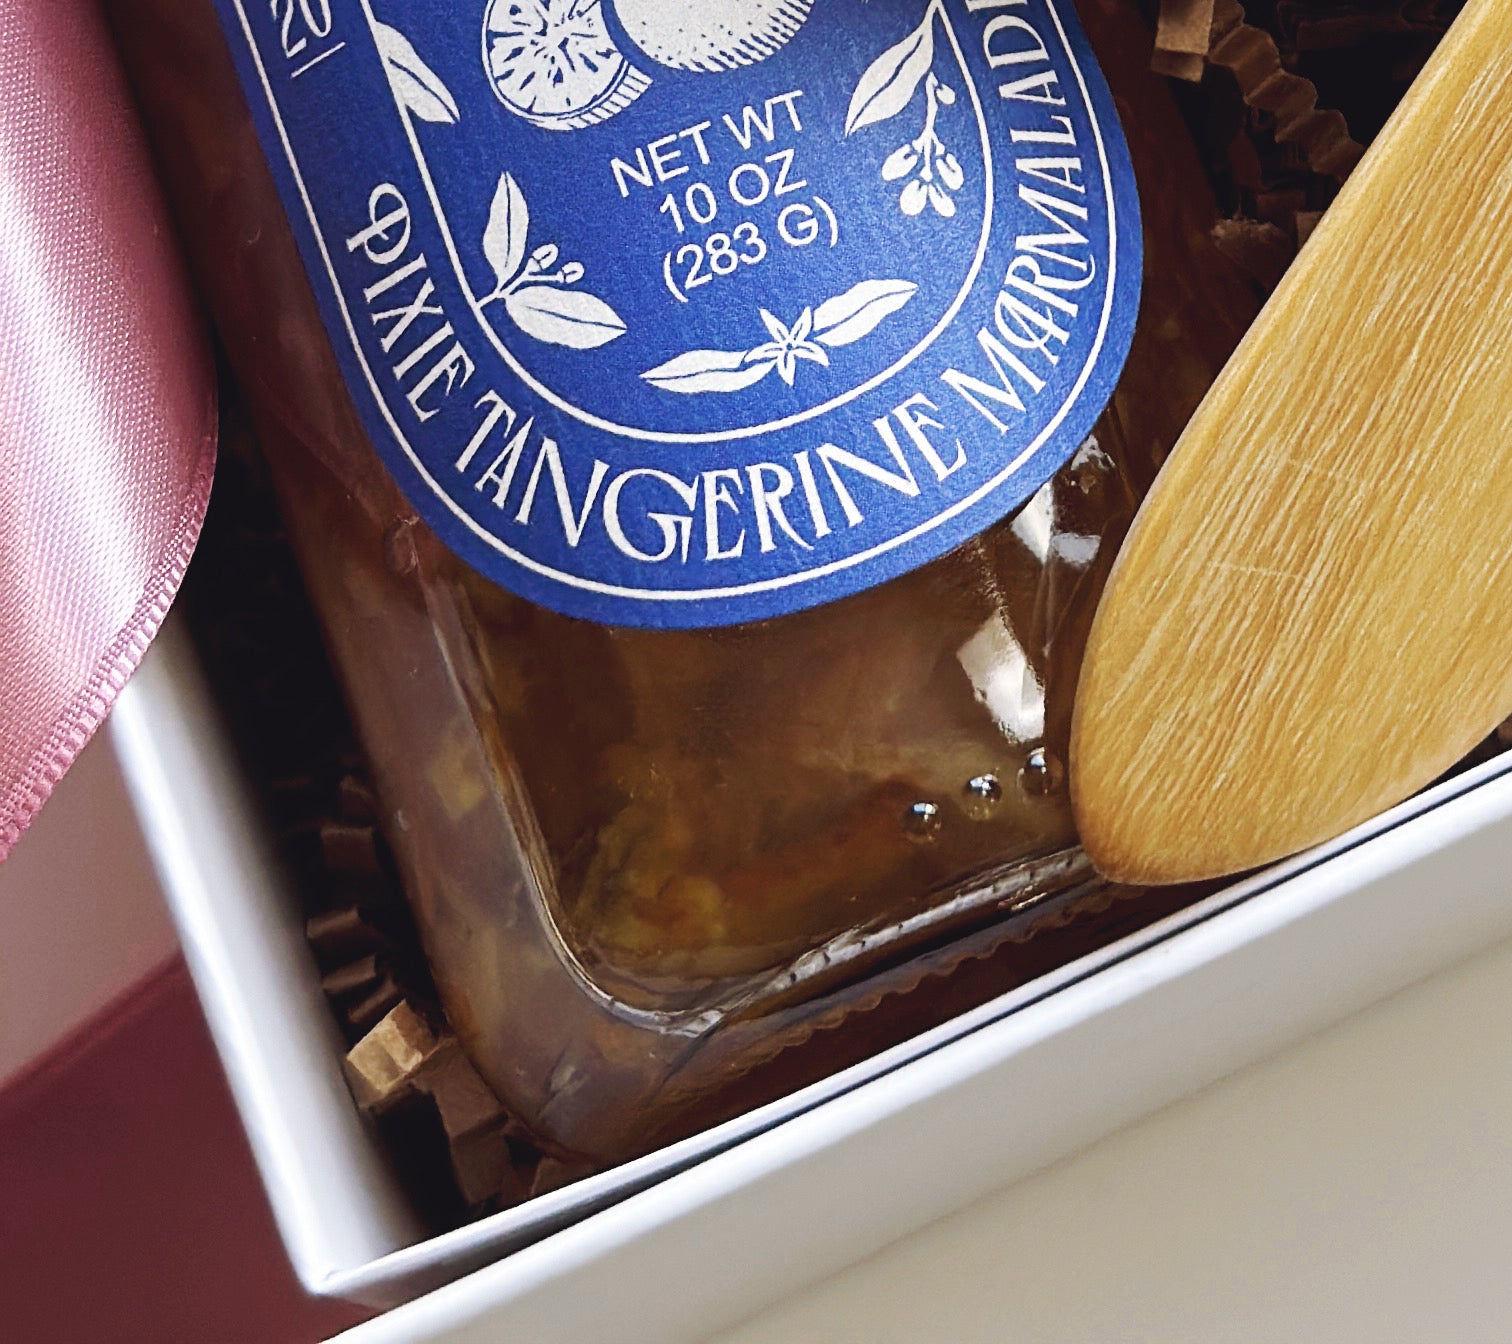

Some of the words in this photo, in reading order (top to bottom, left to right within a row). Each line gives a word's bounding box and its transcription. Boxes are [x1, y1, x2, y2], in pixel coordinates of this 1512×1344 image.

[610, 120, 712, 198] NET
[722, 89, 804, 150] WT
[659, 181, 718, 233] 10
[727, 148, 808, 207] OZ
[663, 220, 768, 304] (283
[777, 195, 839, 249] G)
[345, 182, 475, 424] PIXIE
[455, 387, 968, 566] TANGERINE
